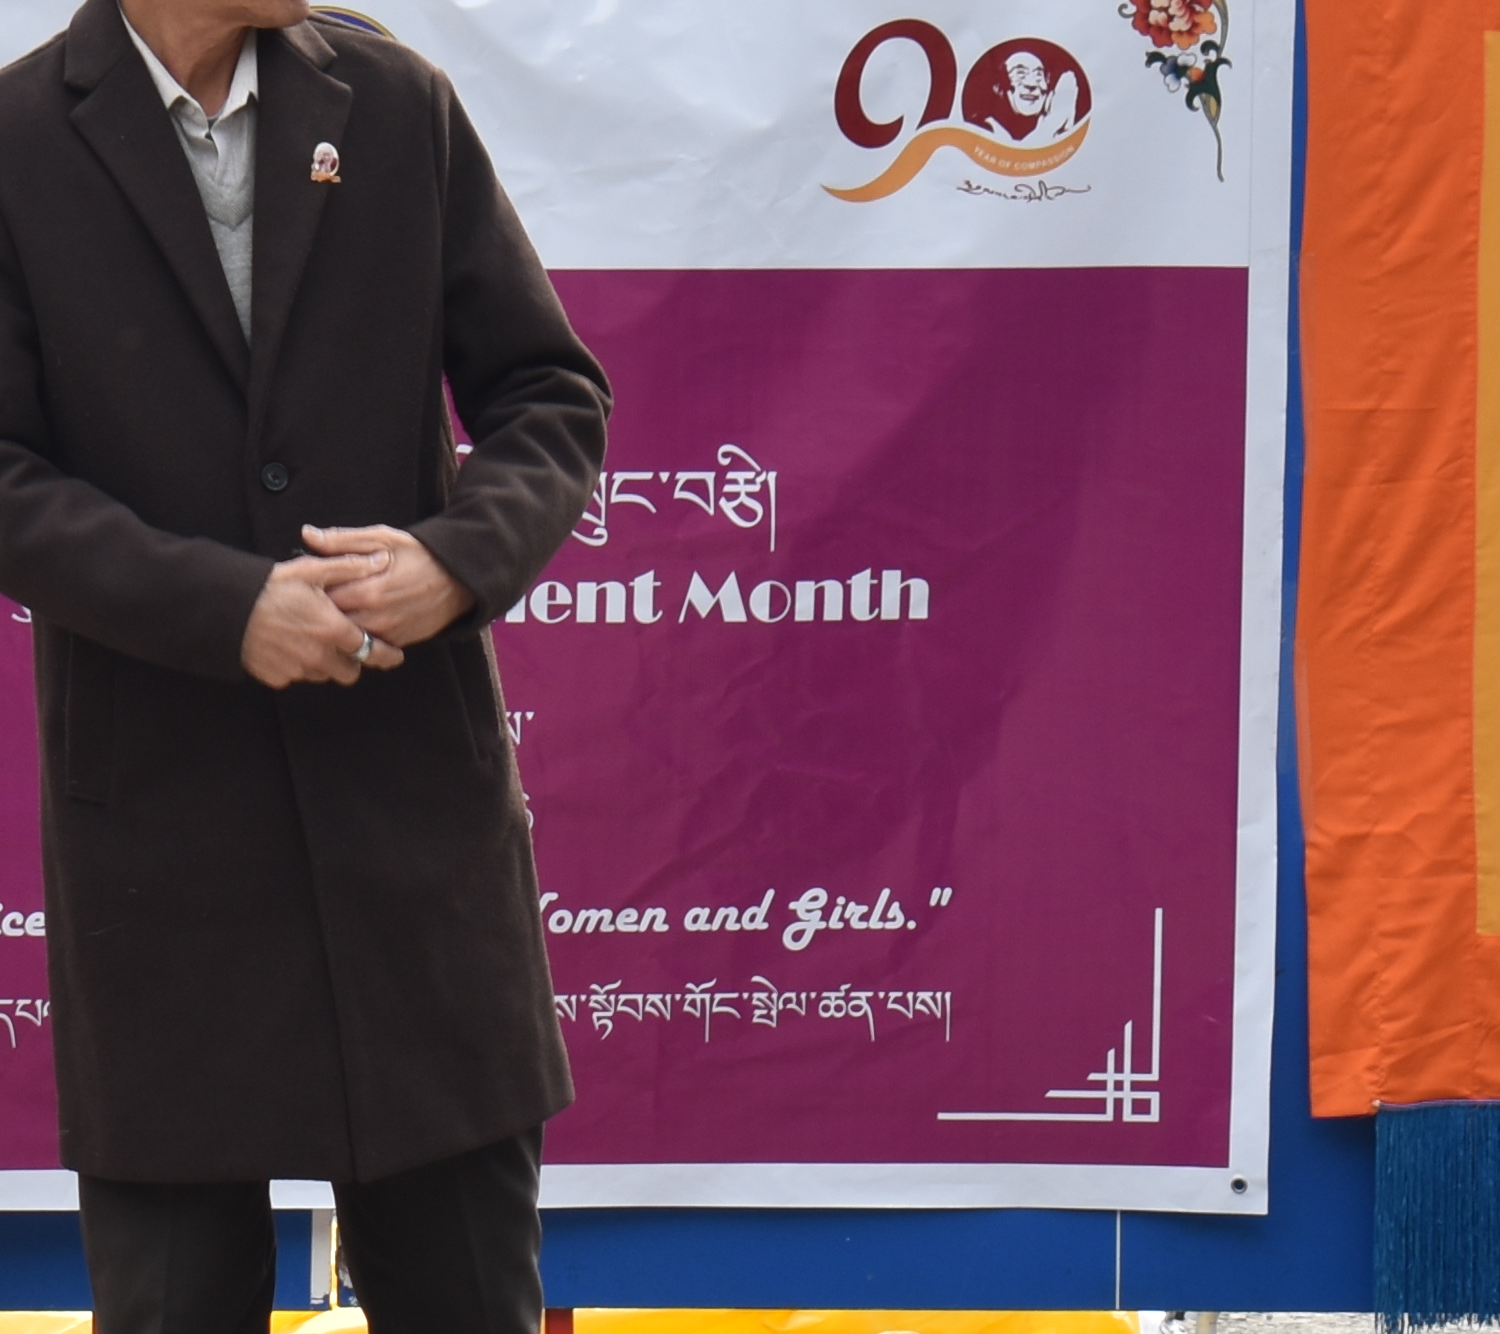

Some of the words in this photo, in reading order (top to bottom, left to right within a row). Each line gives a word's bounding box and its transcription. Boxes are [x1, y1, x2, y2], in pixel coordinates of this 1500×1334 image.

[973, 145, 997, 165] YEAR
[998, 158, 1012, 169] OF
[1013, 144, 1076, 171] COMPASSION
[678, 567, 930, 624] Month
[537, 891, 670, 934] omen
[683, 888, 776, 933] and
